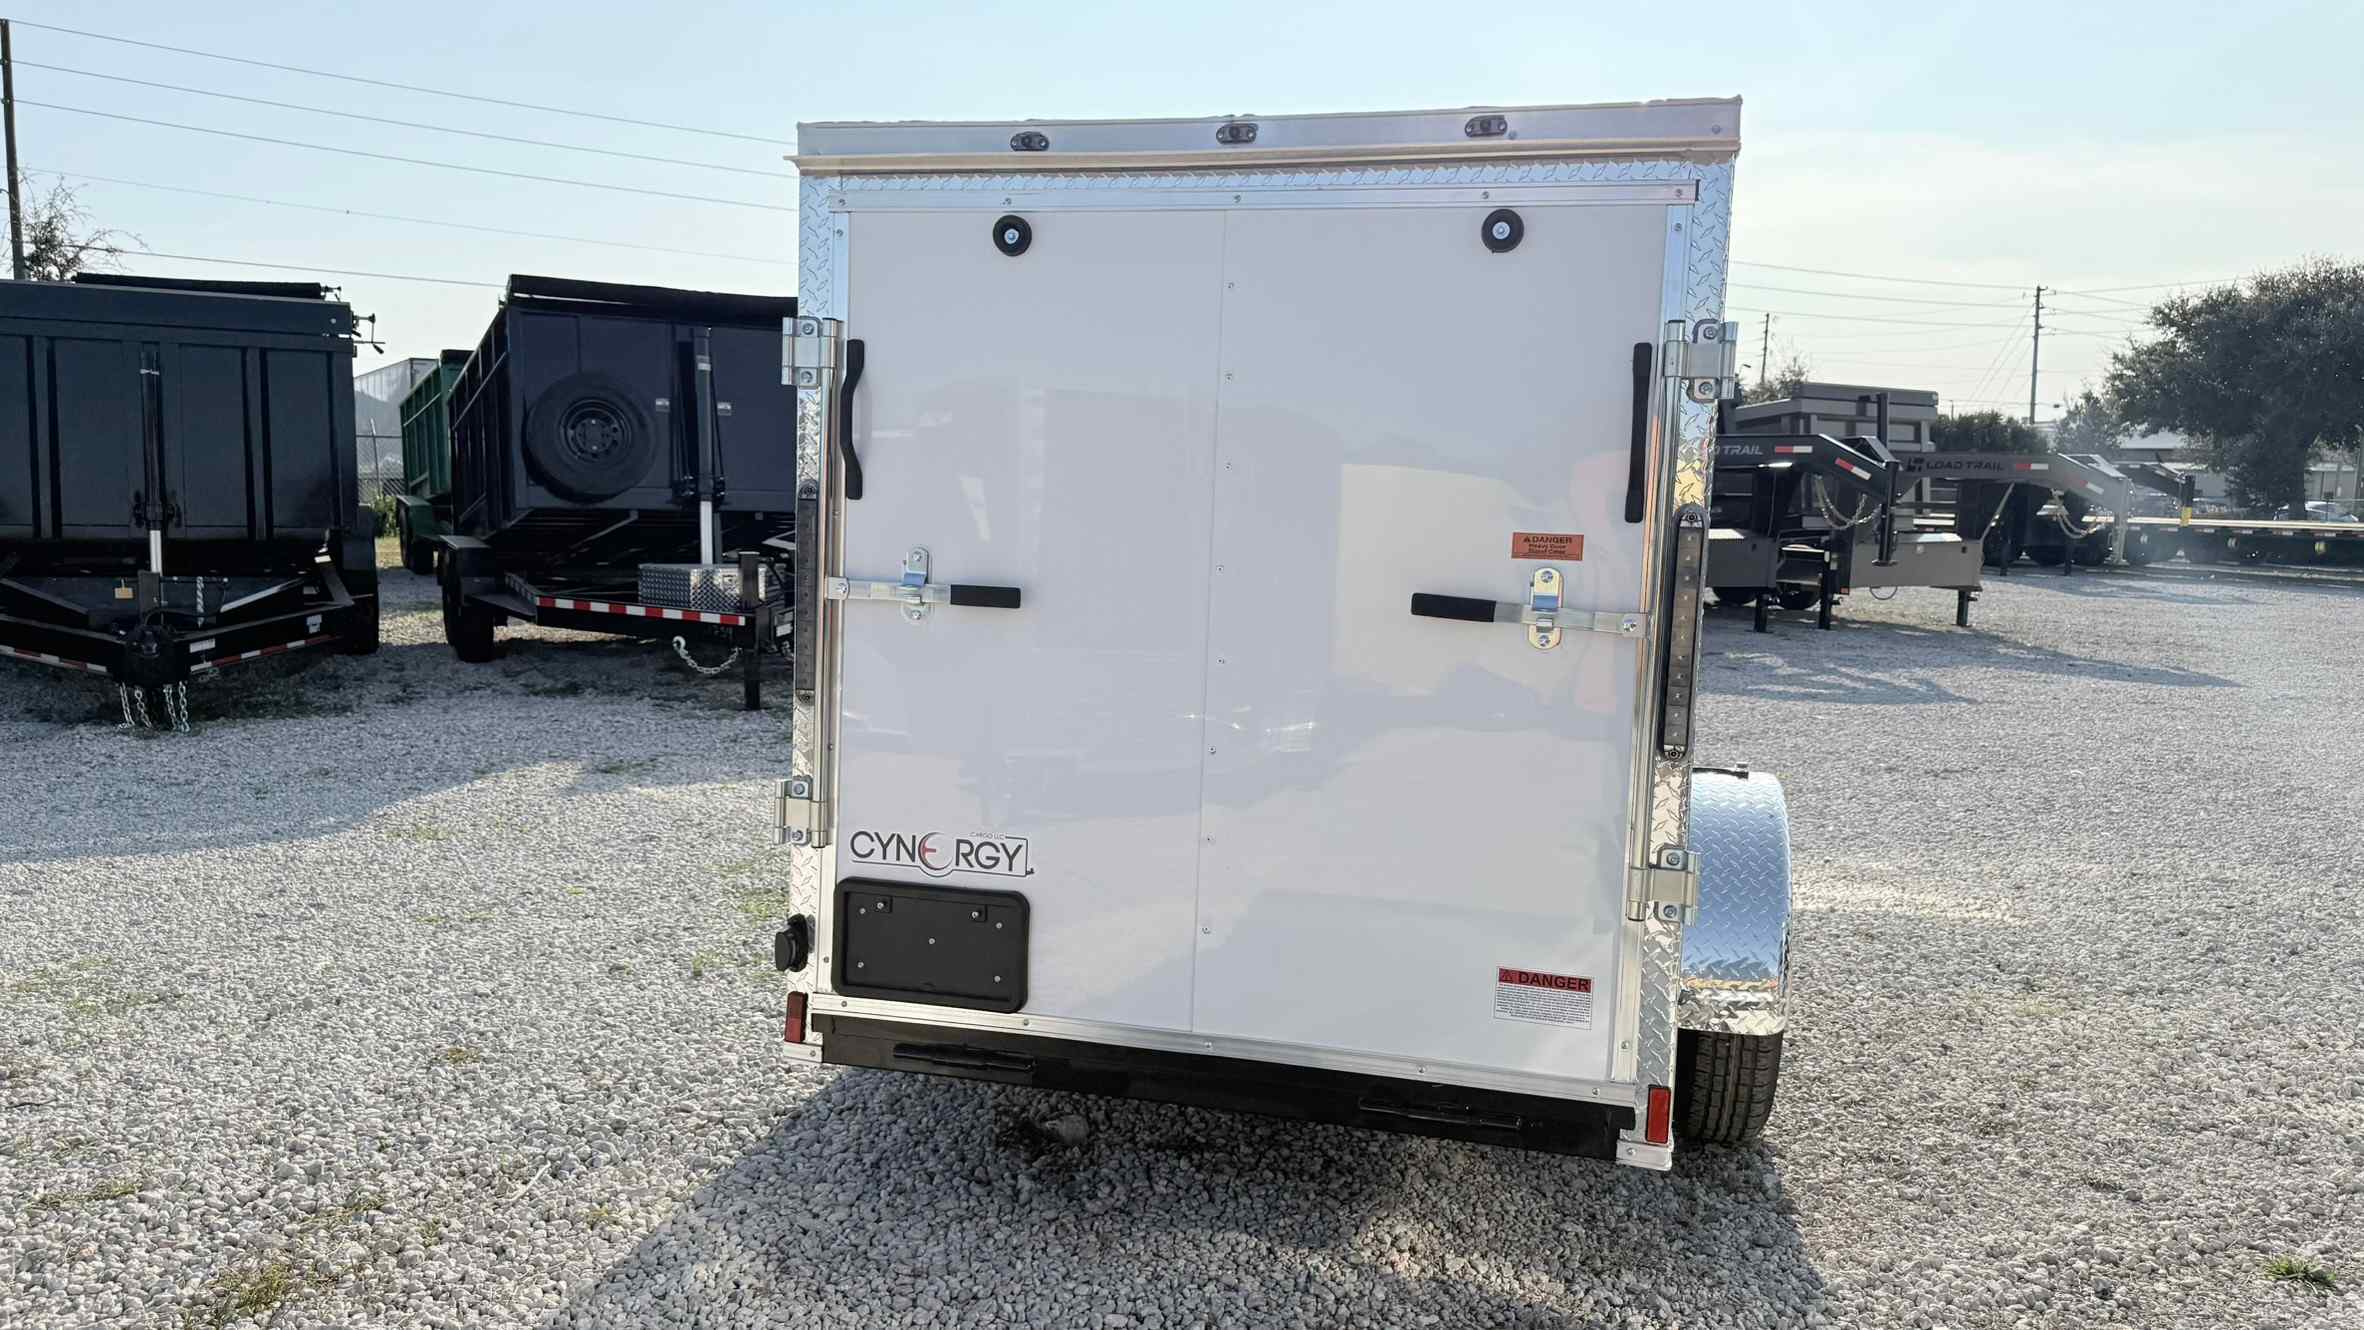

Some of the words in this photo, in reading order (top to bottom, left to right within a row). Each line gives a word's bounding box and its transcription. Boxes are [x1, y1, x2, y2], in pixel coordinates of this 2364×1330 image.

[1723, 445, 1764, 455] TRAIL
[1926, 461, 1962, 471] LOAD
[1966, 461, 2005, 472] TRAIL
[1532, 535, 1573, 544] DANGER
[849, 830, 1024, 872] CYNERGY
[1518, 971, 1589, 991] DANGER
